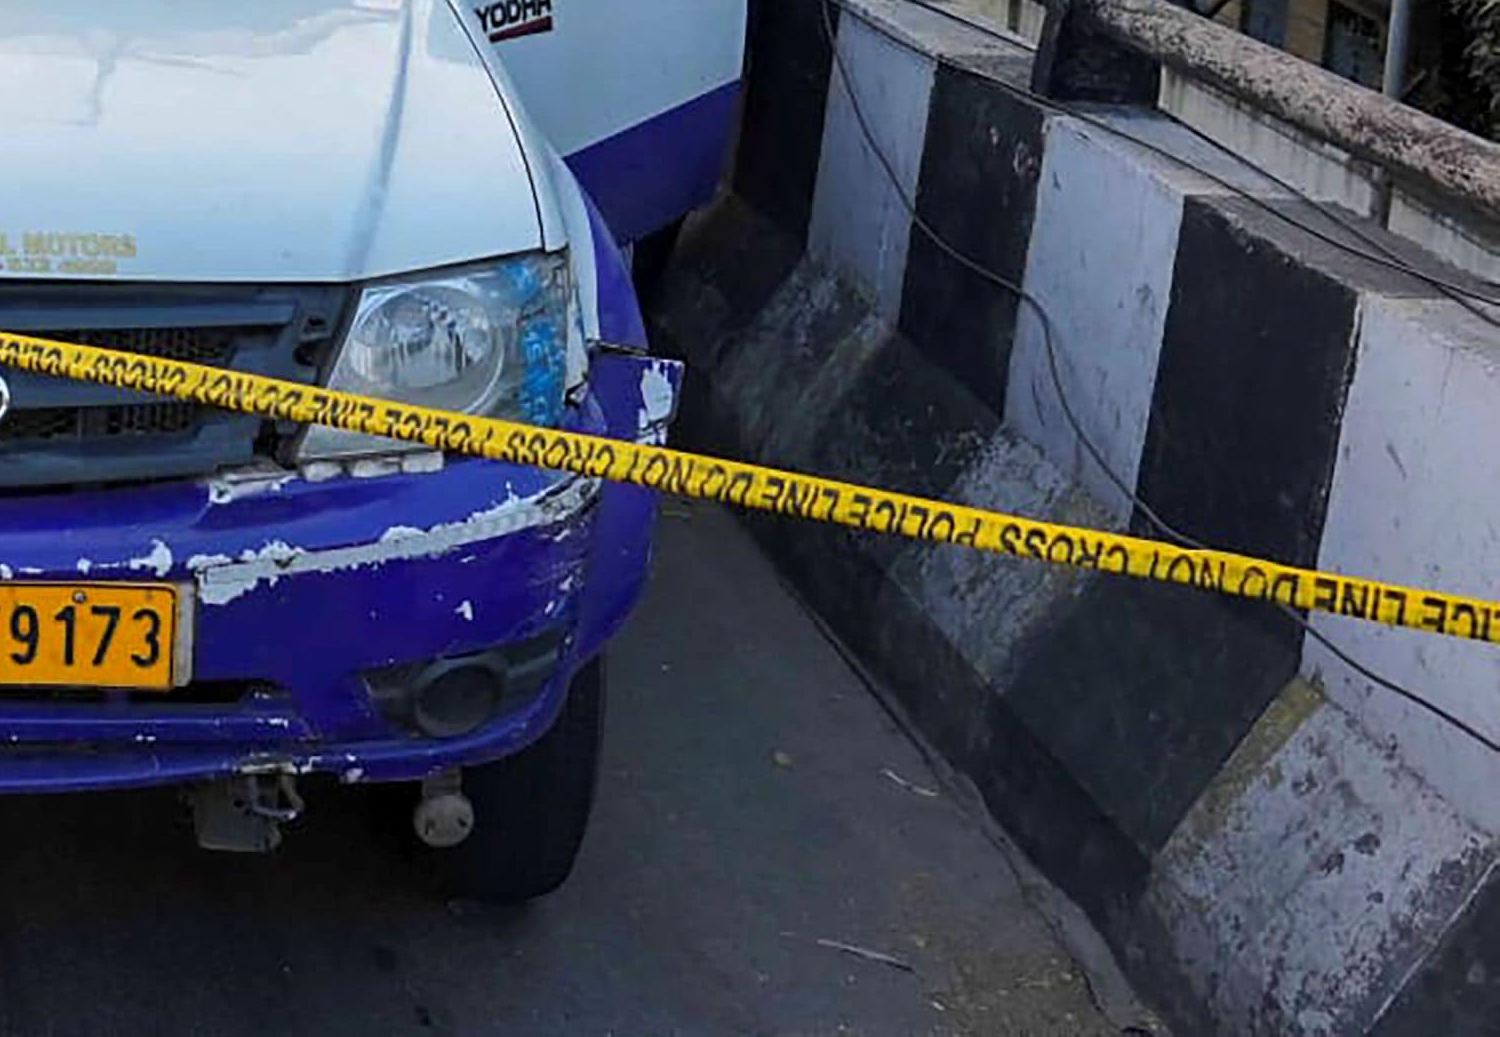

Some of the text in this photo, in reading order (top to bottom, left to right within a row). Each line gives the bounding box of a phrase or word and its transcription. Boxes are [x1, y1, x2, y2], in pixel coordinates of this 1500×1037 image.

[500, 427, 617, 479] CROSS
[697, 464, 753, 505] DO
[759, 476, 841, 521] LINE
[846, 494, 981, 547] POLICE
[997, 522, 1132, 574] CROSS
[1147, 549, 1226, 592] NOT
[1238, 565, 1300, 605] DO
[1310, 577, 1408, 625] LINE
[1418, 597, 1500, 642] ICE
